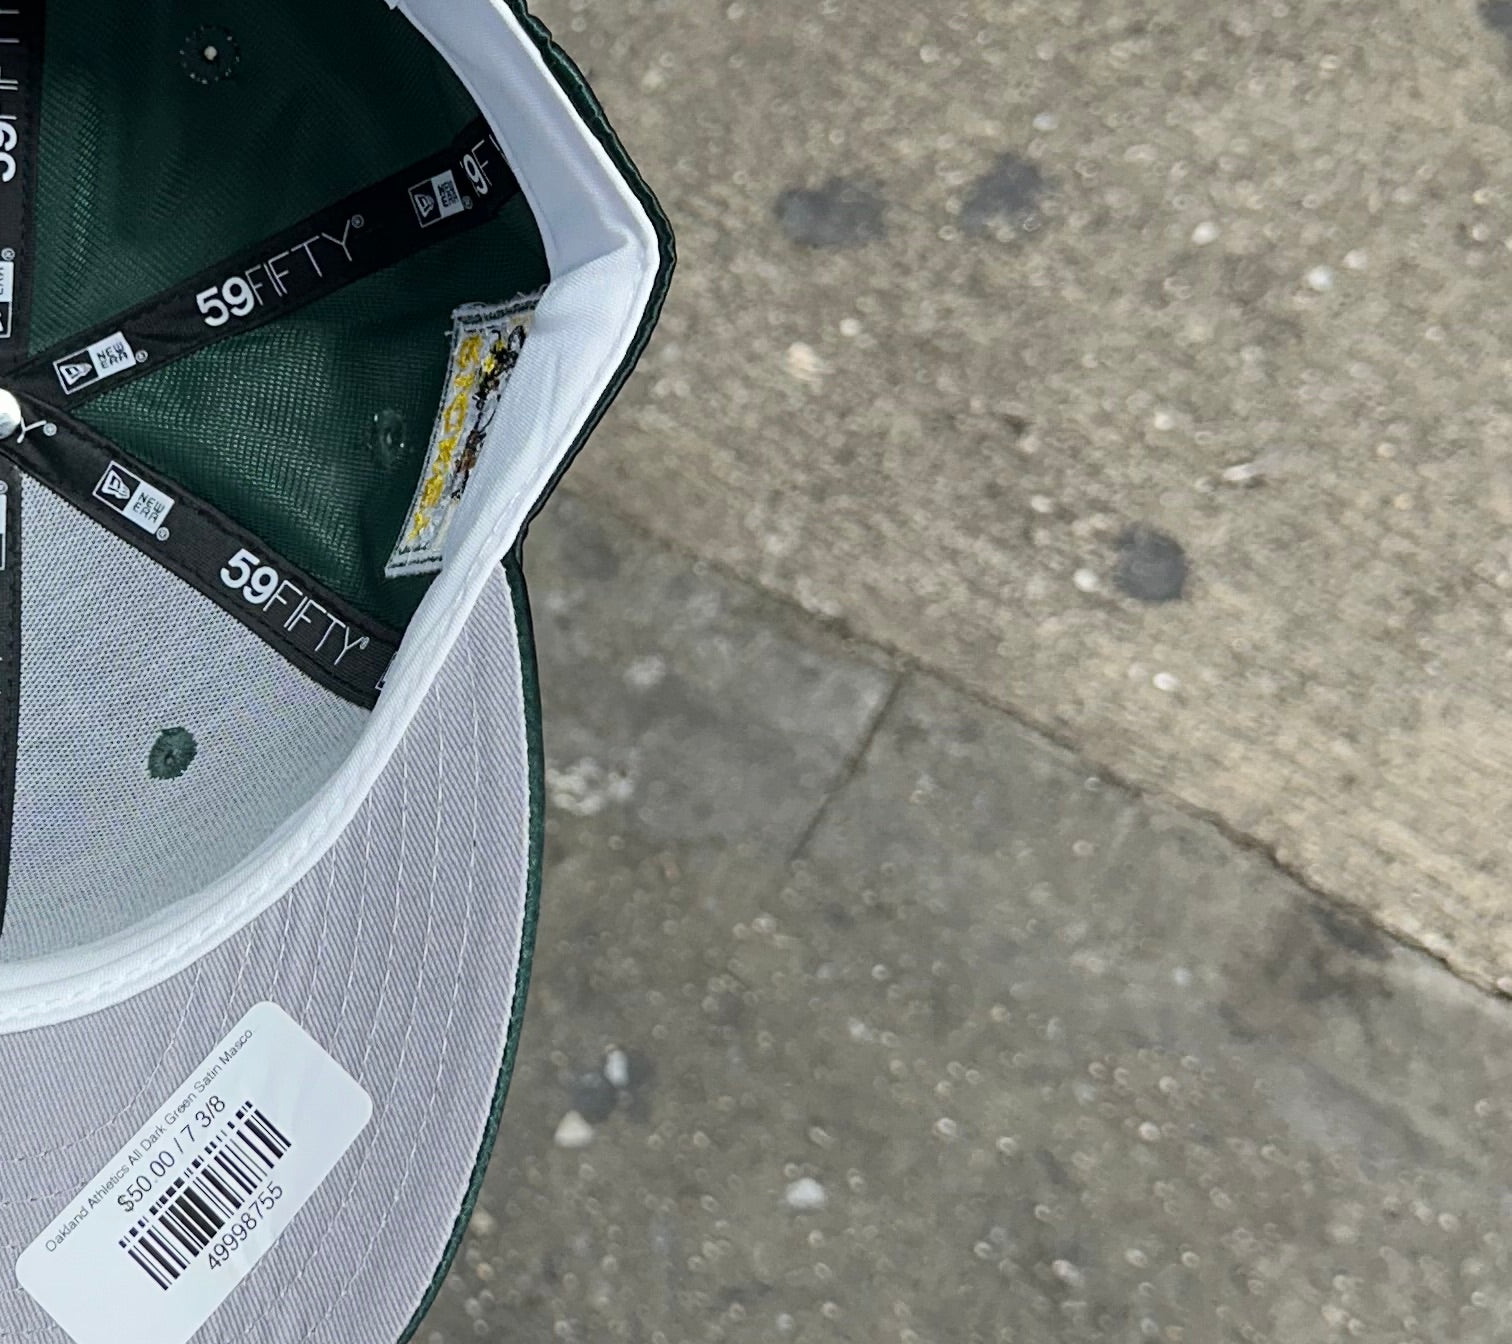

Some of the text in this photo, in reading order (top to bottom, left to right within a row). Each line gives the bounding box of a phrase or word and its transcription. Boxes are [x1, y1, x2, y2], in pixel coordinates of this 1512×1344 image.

[97, 342, 124, 360] NEW
[132, 501, 159, 524] ERA
[138, 492, 165, 514] NEW
[45, 1029, 253, 1252] Oakland Athletics All Dark Green Satin Masco
[117, 1150, 176, 1213] $50.00
[179, 1124, 196, 1143] 7
[195, 1095, 226, 1128] 3/8
[207, 1181, 284, 1271] 49998755
